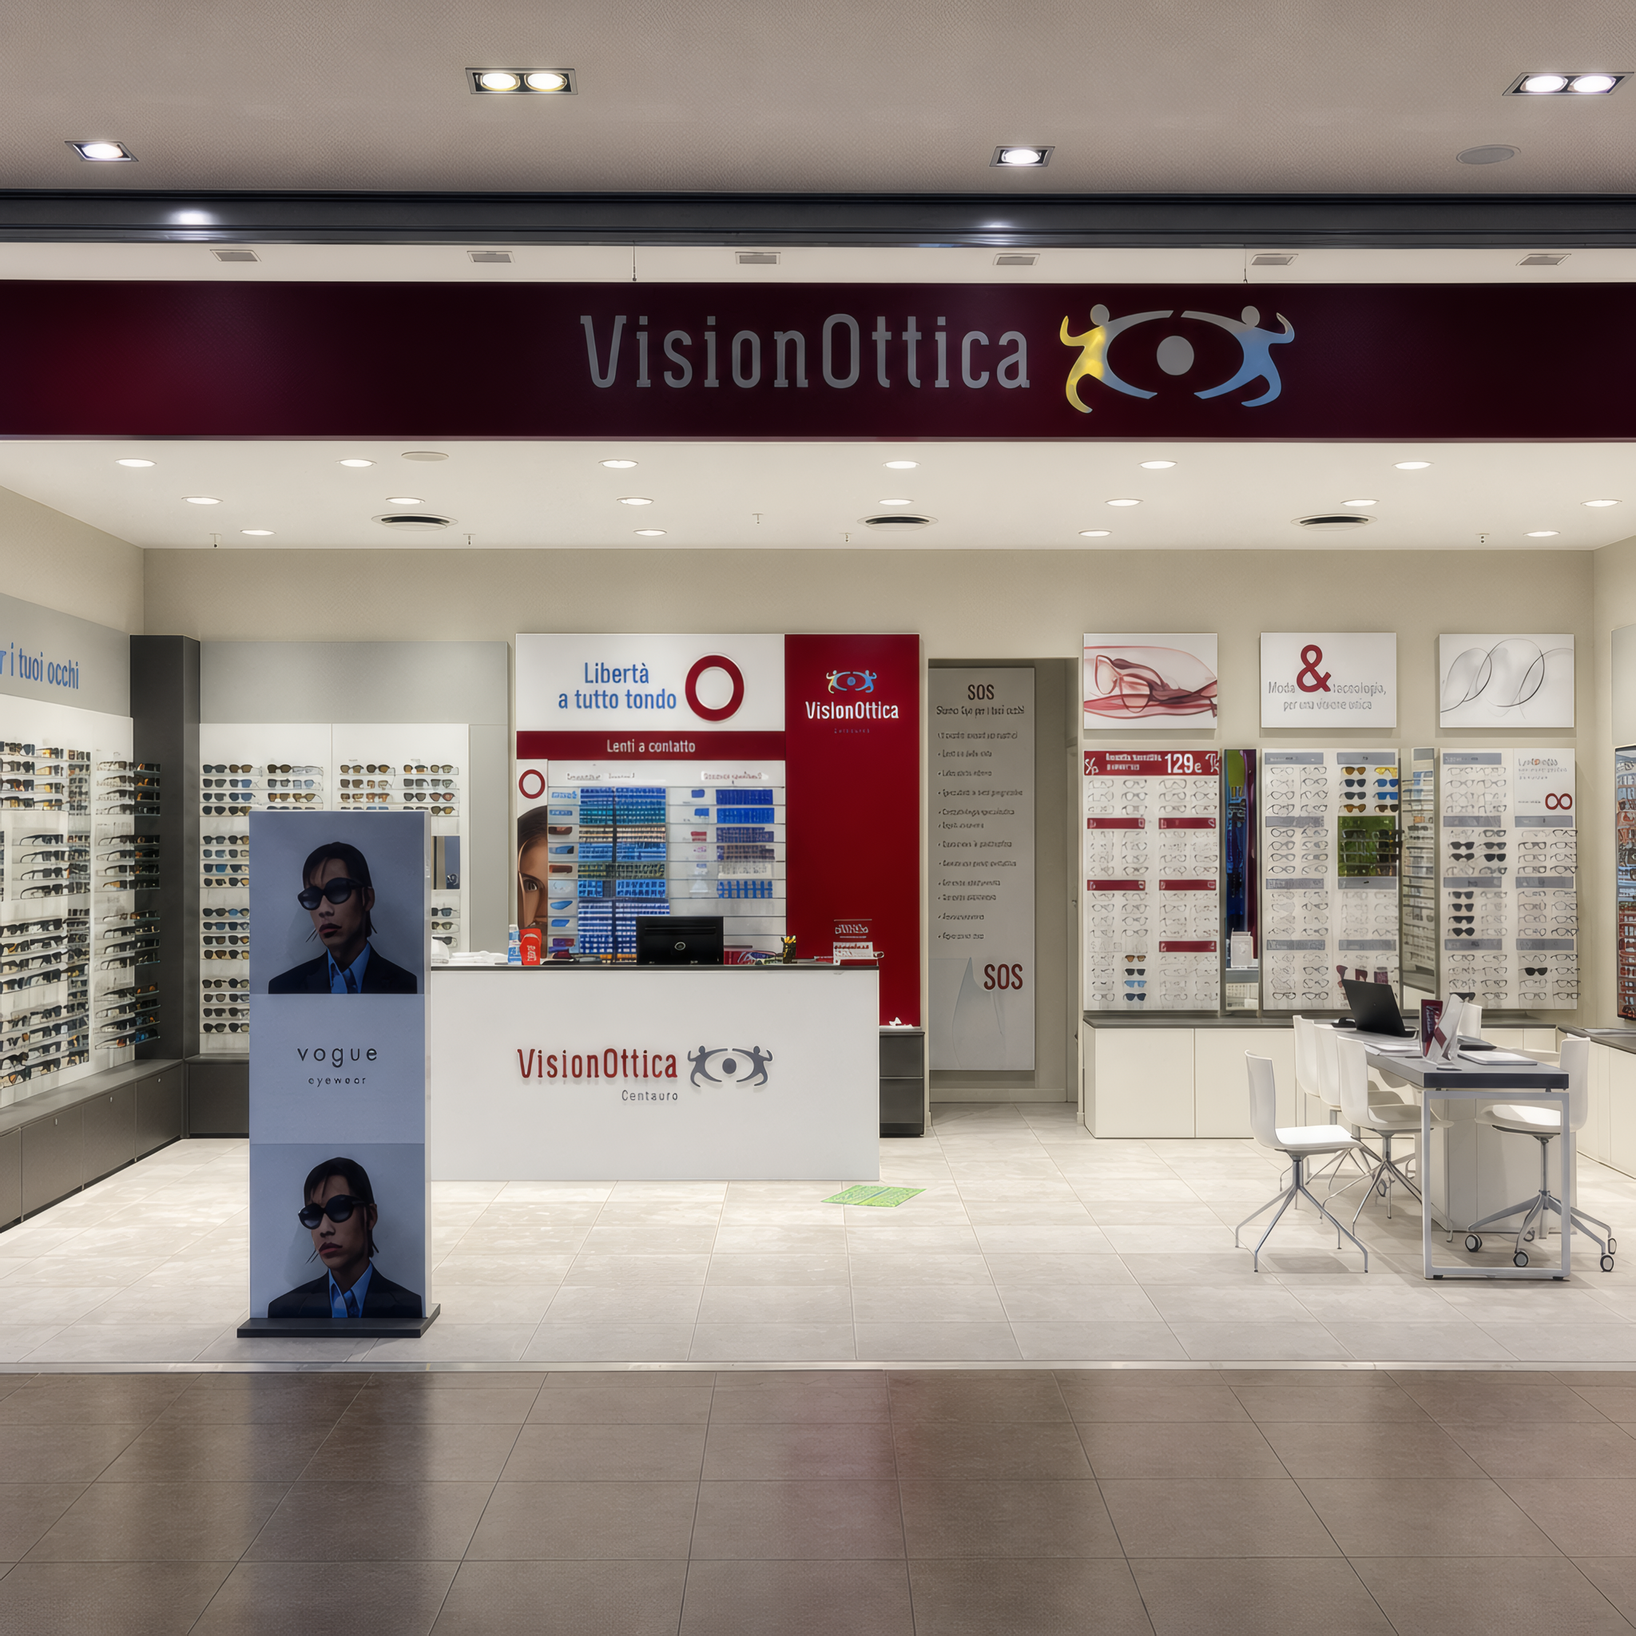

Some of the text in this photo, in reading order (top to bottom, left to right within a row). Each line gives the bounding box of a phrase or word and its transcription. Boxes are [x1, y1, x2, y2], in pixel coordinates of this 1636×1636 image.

[580, 313, 1031, 389] VisionOttica
[10, 642, 14, 676] i
[18, 648, 44, 682] tuoi
[47, 659, 79, 690] occhi
[584, 662, 649, 684] Libertà
[558, 688, 677, 709] a tutto tondo
[967, 684, 995, 701] SOS
[607, 739, 635, 753] Lenti
[638, 742, 646, 753] a
[983, 963, 1024, 991] SOS
[297, 1048, 378, 1068] vogue
[516, 1048, 678, 1079] VisionOttica
[621, 1089, 679, 1102] Centauro
